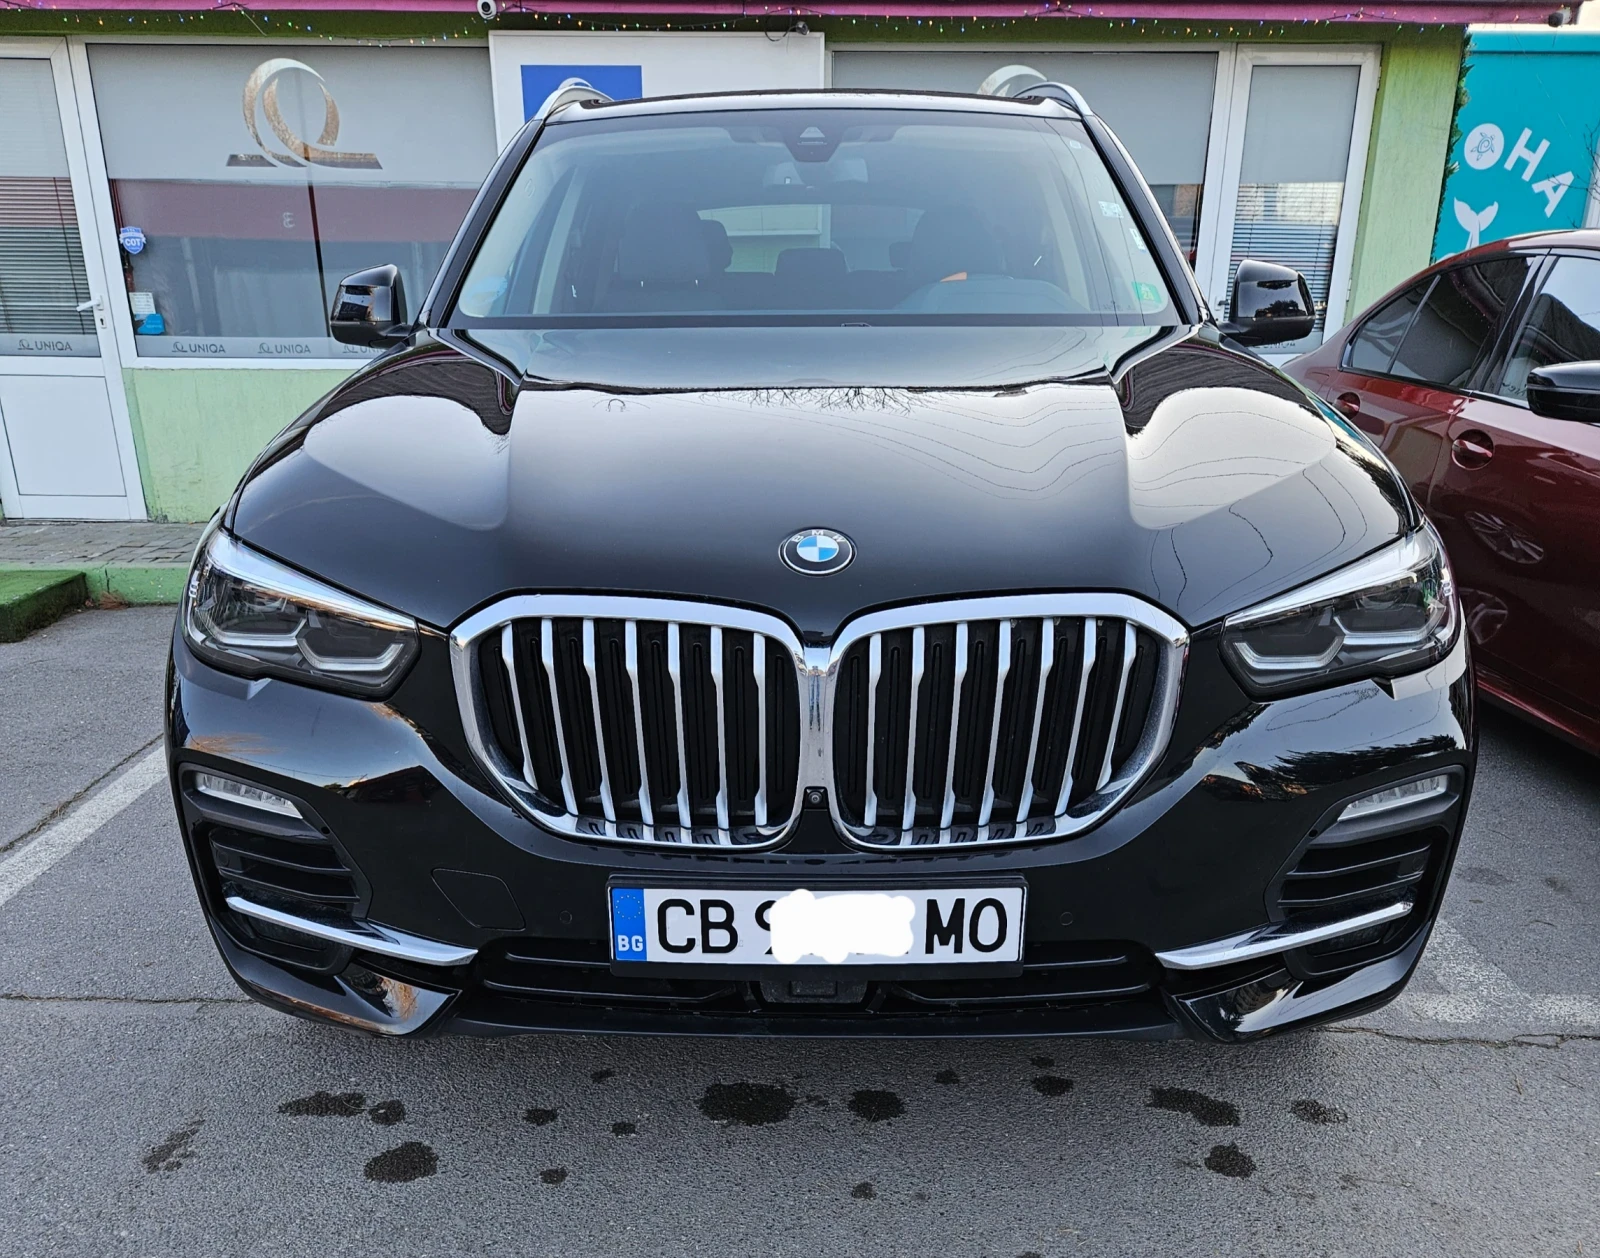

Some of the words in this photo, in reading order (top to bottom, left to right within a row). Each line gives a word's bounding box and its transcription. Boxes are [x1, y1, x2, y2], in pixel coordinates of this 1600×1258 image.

[34, 340, 73, 351] UNIQA
[188, 343, 226, 354] UNIQA
[274, 344, 312, 354] UNIQA
[657, 898, 738, 954] CB
[925, 897, 1008, 954] MO
[617, 934, 644, 952] BG
